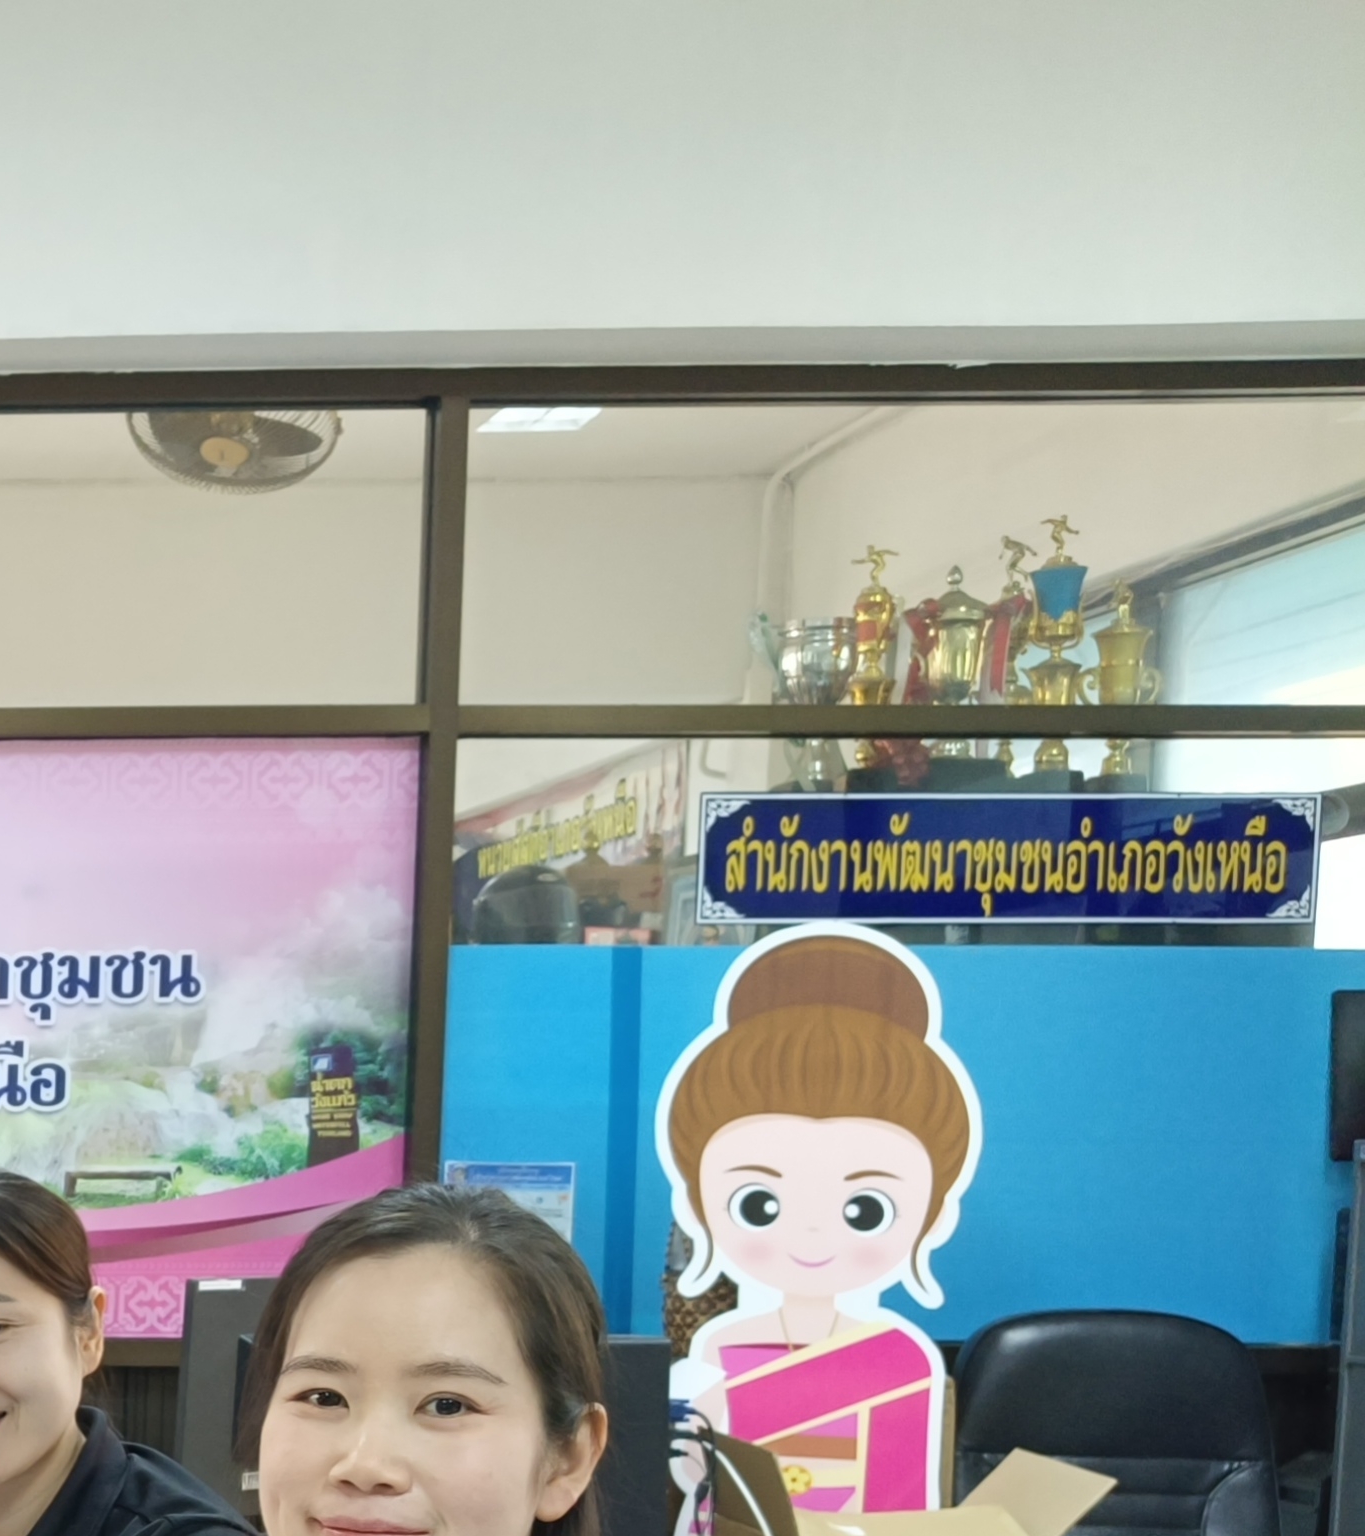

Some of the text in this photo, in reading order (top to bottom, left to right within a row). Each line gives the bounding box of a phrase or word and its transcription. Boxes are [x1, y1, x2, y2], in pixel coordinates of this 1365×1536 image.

[725, 811, 1287, 918] สำนักงานพัฒนาชุมชนอำเภอวังเหนือ
